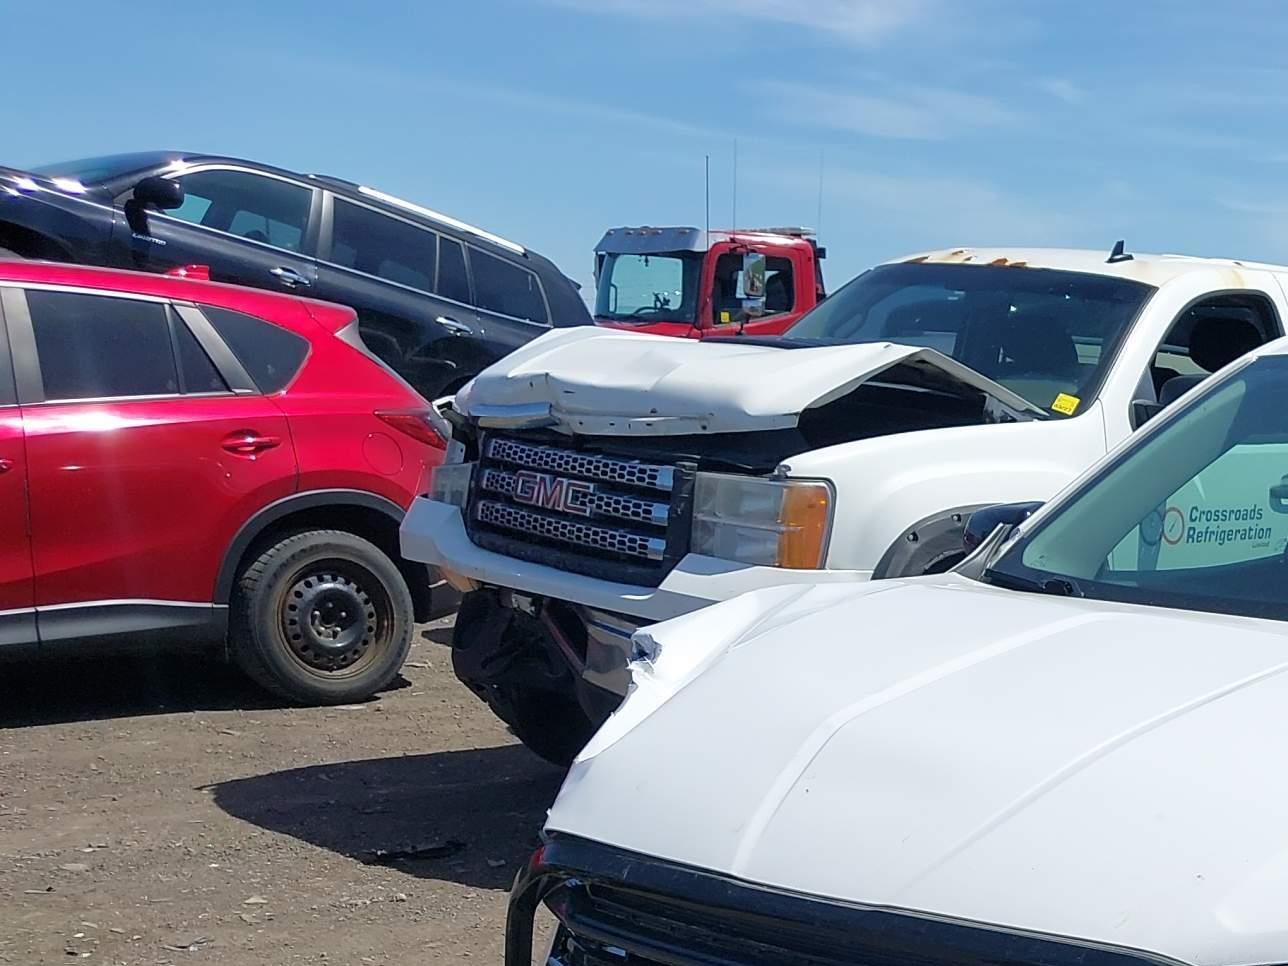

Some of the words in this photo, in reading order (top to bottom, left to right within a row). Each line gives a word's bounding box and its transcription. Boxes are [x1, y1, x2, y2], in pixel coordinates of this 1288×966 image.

[513, 469, 594, 517] GMC
[1189, 504, 1263, 523] Crossroads
[1186, 523, 1272, 546] Refrigeration
